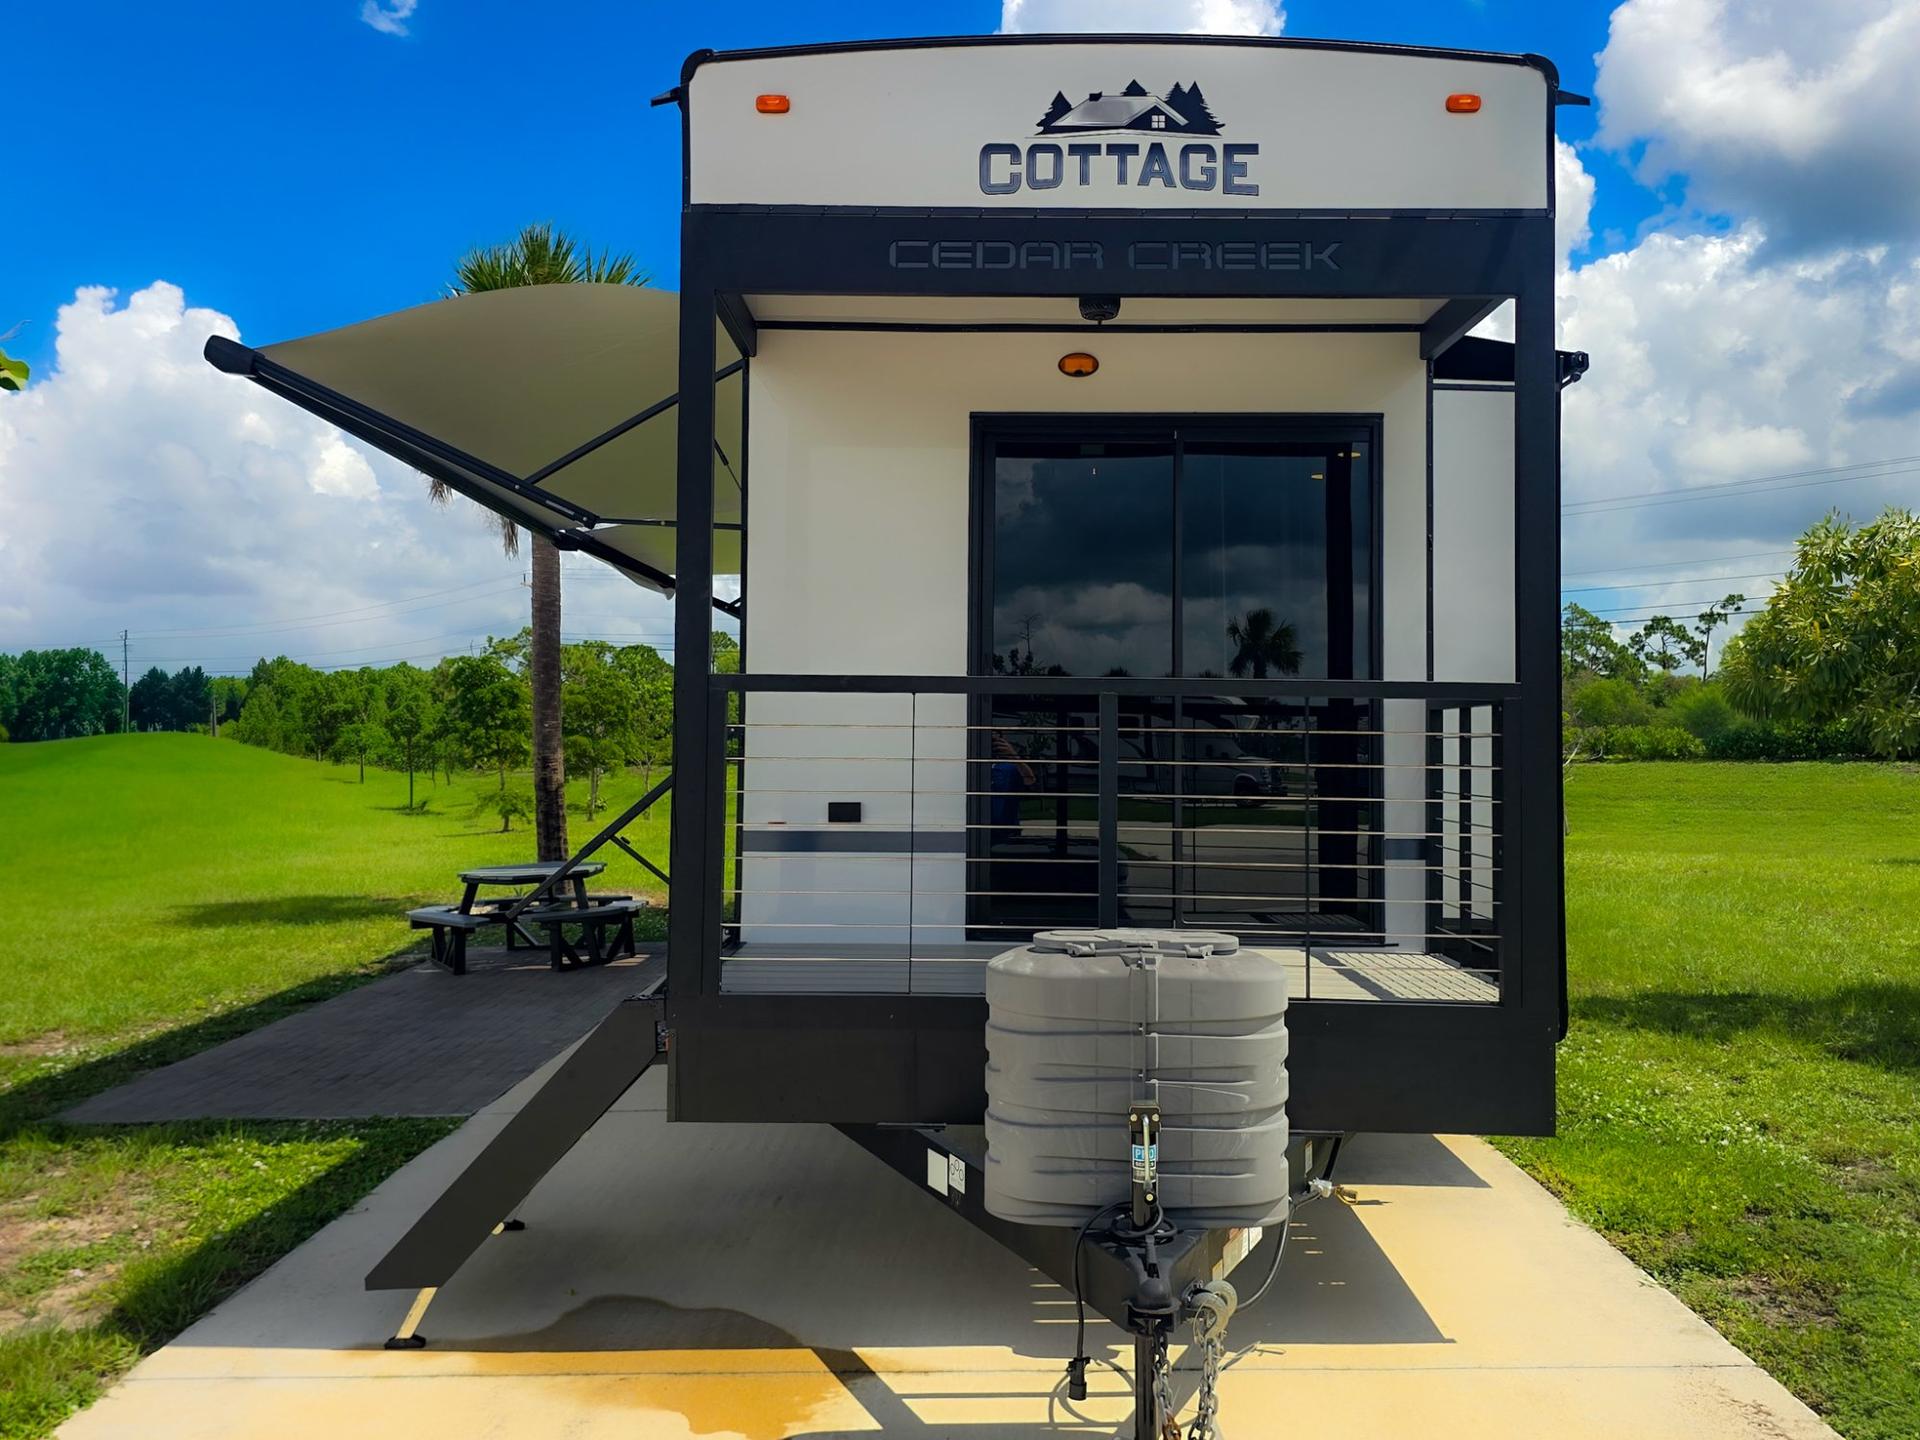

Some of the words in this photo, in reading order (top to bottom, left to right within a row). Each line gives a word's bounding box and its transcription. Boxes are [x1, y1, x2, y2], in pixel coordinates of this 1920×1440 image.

[979, 142, 1260, 197] COTTAGE
[888, 240, 1105, 270] CEDAR
[1128, 240, 1344, 271] CREEK
